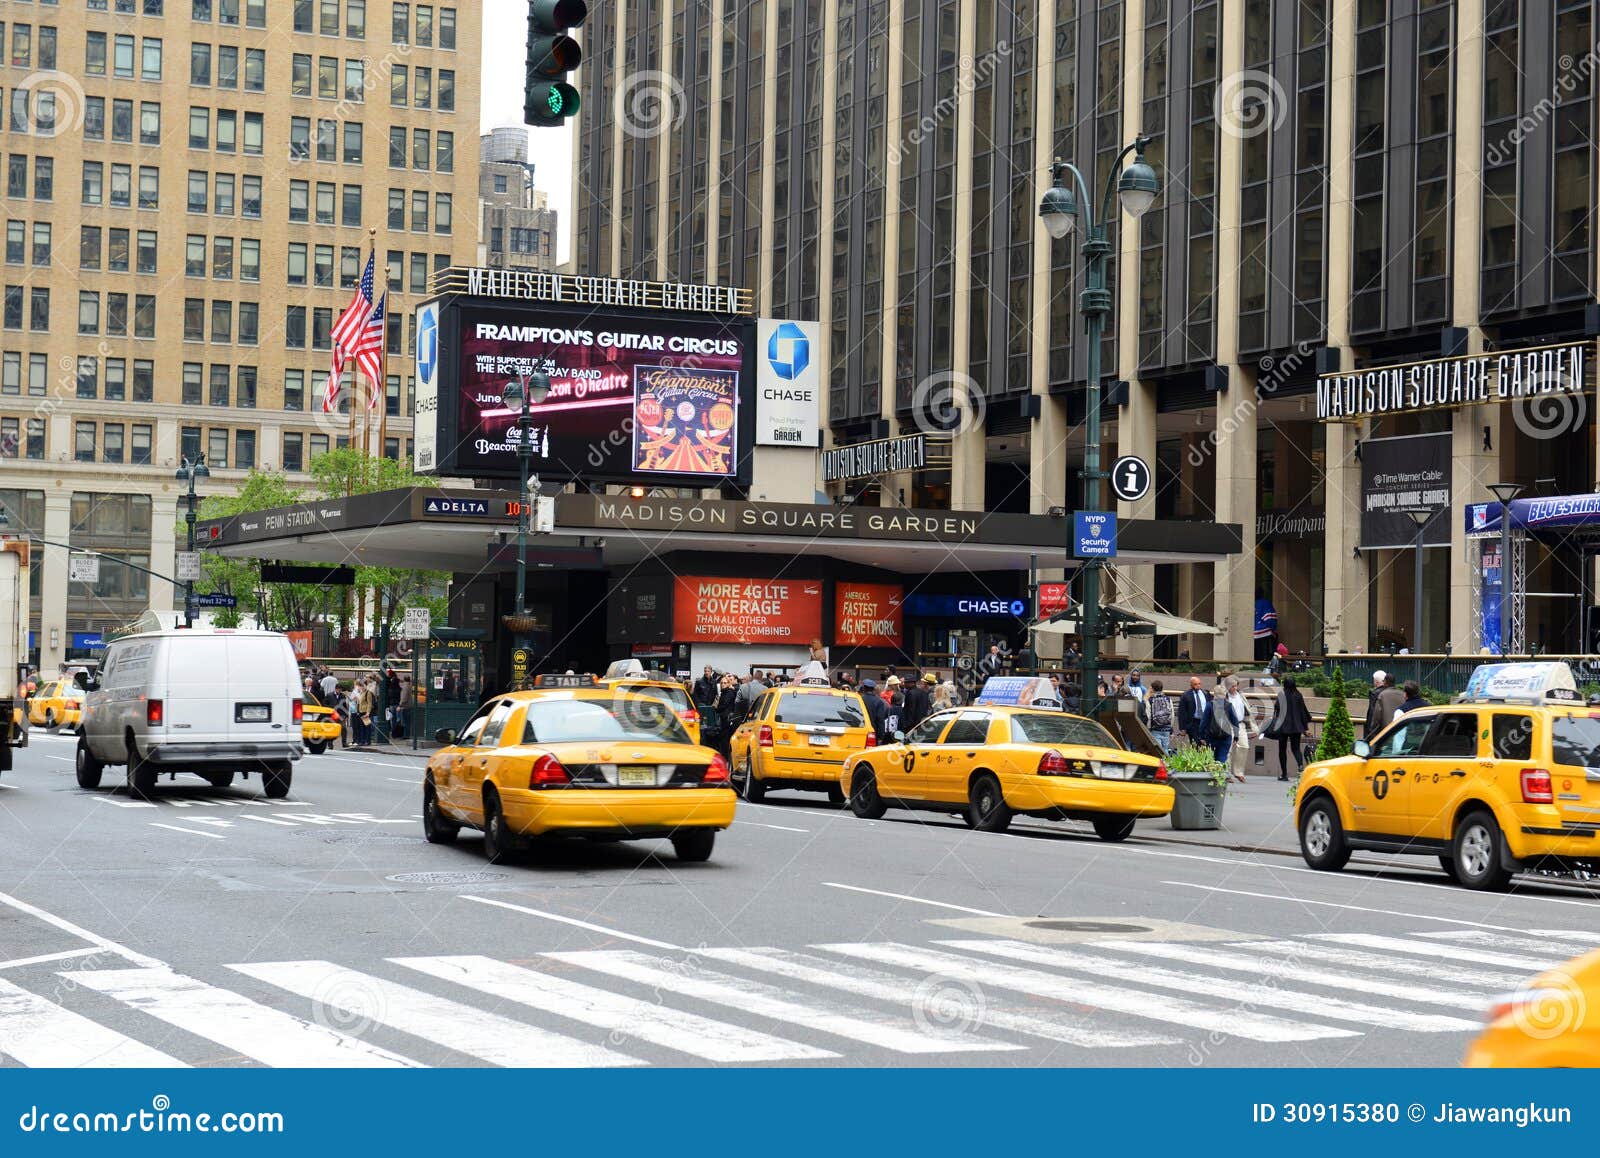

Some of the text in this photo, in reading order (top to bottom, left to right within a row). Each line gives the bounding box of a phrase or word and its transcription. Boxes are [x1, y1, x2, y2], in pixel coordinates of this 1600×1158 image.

[468, 268, 738, 314] MADISON SQUARE GARDEN
[476, 323, 738, 356] FRAMPTON'S GUITAR CIRCUS
[476, 355, 555, 367] WITH SUPPORT FOM
[476, 363, 494, 373] THE
[572, 369, 601, 379] BAND
[575, 373, 629, 398] Theatre
[646, 370, 728, 395] Frampton's
[1316, 346, 1584, 419] MADISON SQUARE GARDEN
[476, 393, 501, 403] June
[764, 389, 812, 401] CHASE
[416, 396, 437, 414] CHASE
[774, 429, 802, 442] GARDEN
[821, 436, 924, 481] MADISON SQUARE GARDEN
[1382, 471, 1441, 484] Time Warner Cable
[441, 502, 485, 512] DELTA
[1367, 489, 1449, 512] MADISON SQUARE GARDEN
[265, 514, 284, 529] PENN
[287, 510, 316, 527] STATION
[600, 504, 976, 534] MADISON SQUARE GARDEN
[1081, 538, 1110, 547] Security
[1081, 546, 1109, 554] Camera
[698, 584, 740, 598] MORE
[743, 585, 762, 598] 4G
[765, 587, 788, 600] LTE
[697, 599, 782, 615] COVERAGE
[843, 601, 878, 617] FASTEST
[959, 600, 1008, 613] CHASE
[696, 615, 767, 625] THAN ALL OTHER
[841, 618, 897, 636] 4G NETWORK.
[695, 625, 791, 636] NETWORKS COMBINED
[556, 677, 580, 686] TAXI
